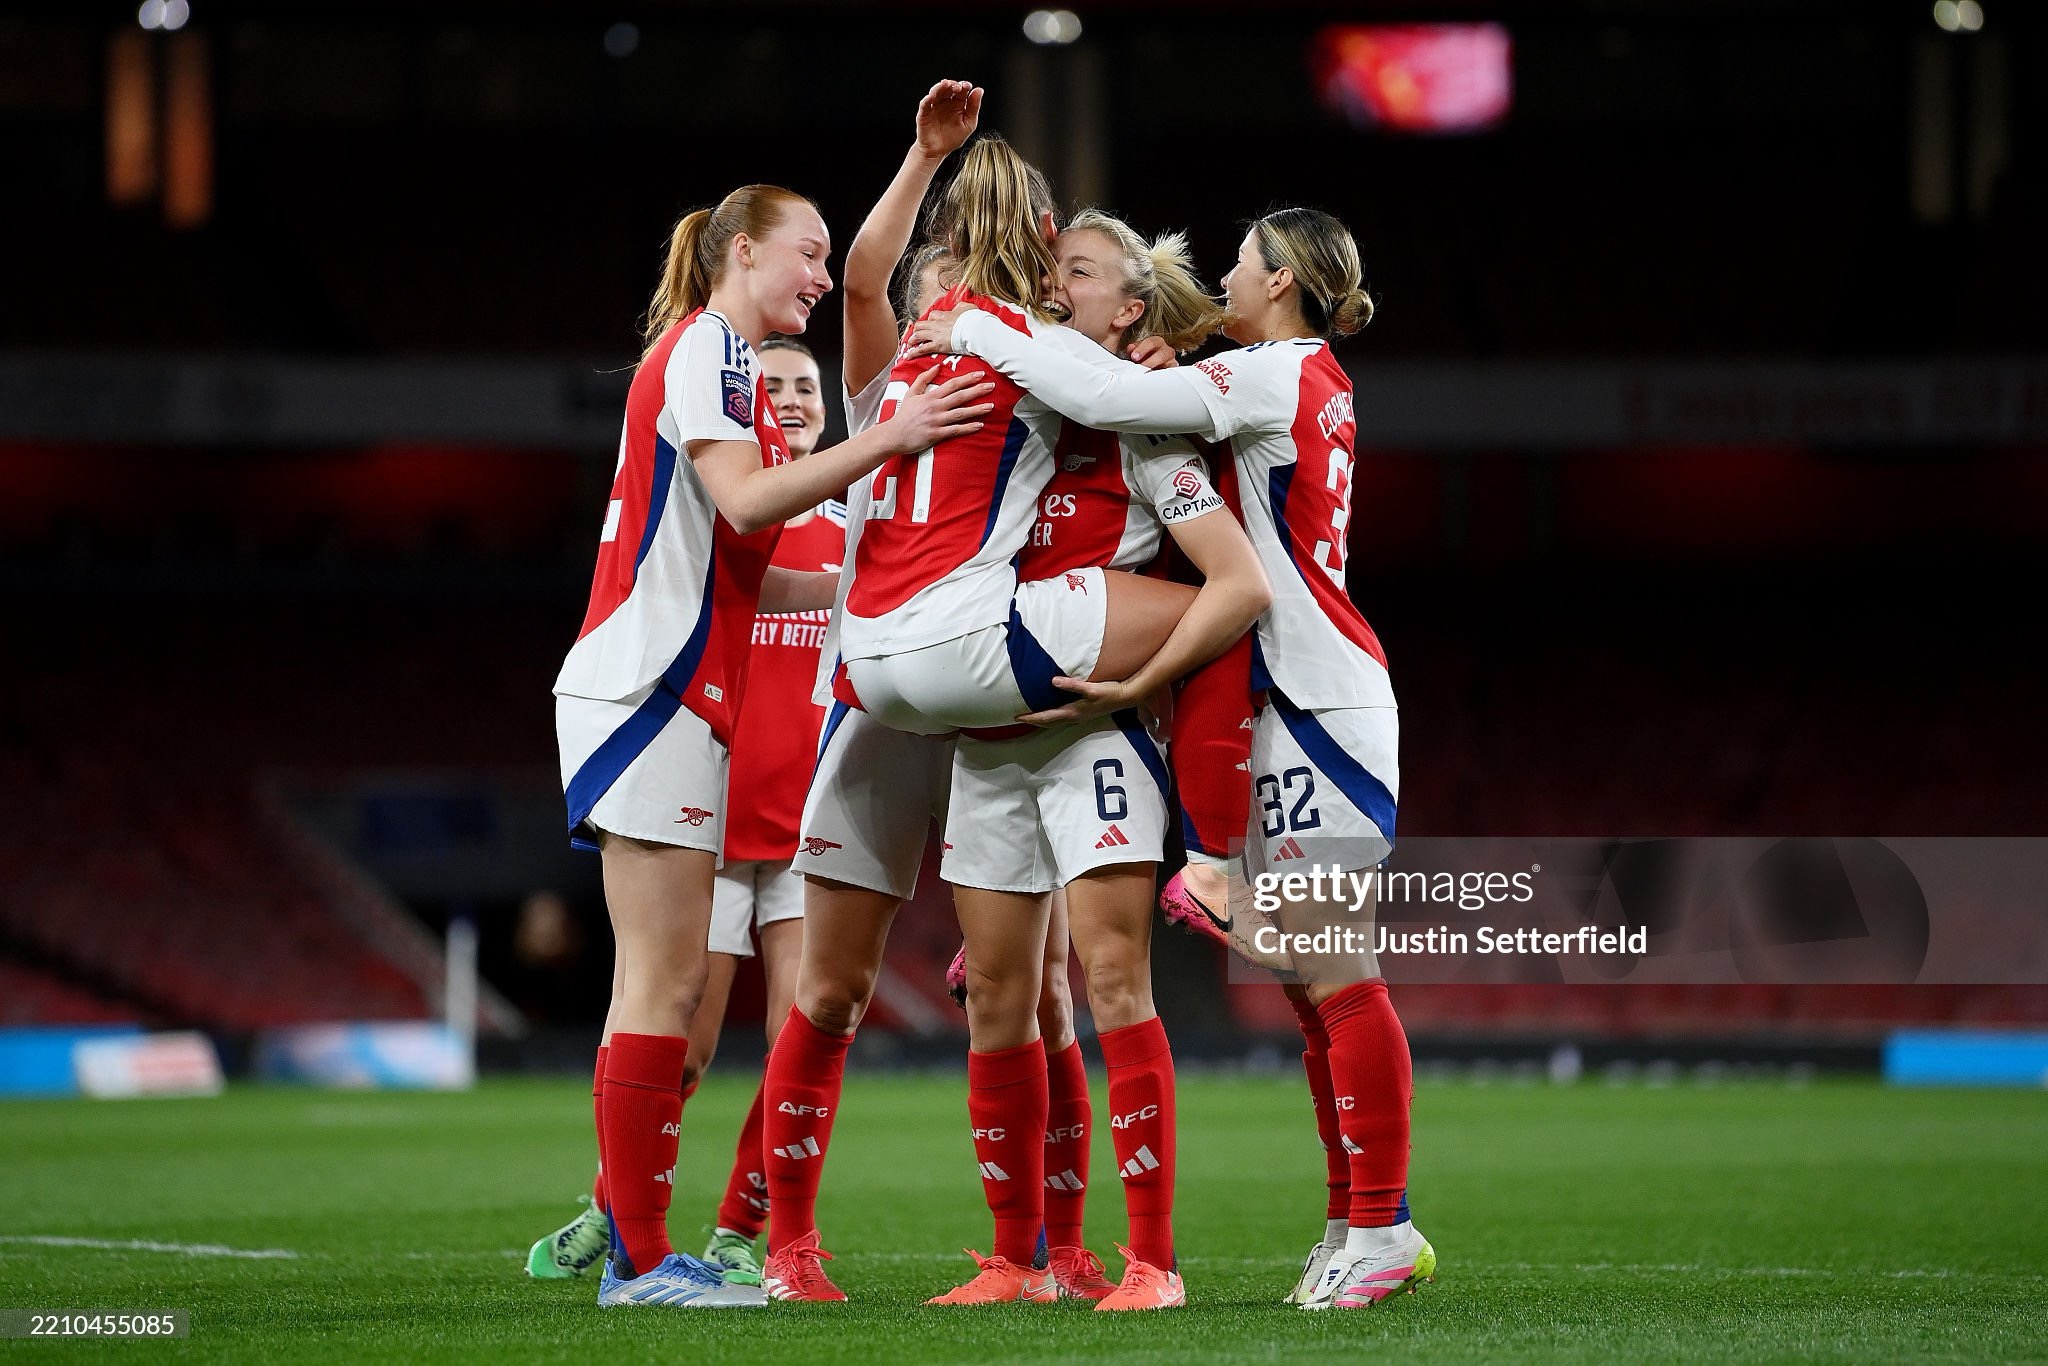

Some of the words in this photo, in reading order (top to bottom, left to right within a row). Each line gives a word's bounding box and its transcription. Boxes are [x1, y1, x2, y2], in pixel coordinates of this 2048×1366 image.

[1162, 496, 1223, 520] CAPTAIN
[750, 622, 779, 646] FLY
[1092, 758, 1129, 821] 6
[1255, 766, 1322, 838] 32
[778, 1101, 829, 1118] AFC
[1111, 1104, 1158, 1130] AFC
[1044, 1123, 1084, 1144] AFC
